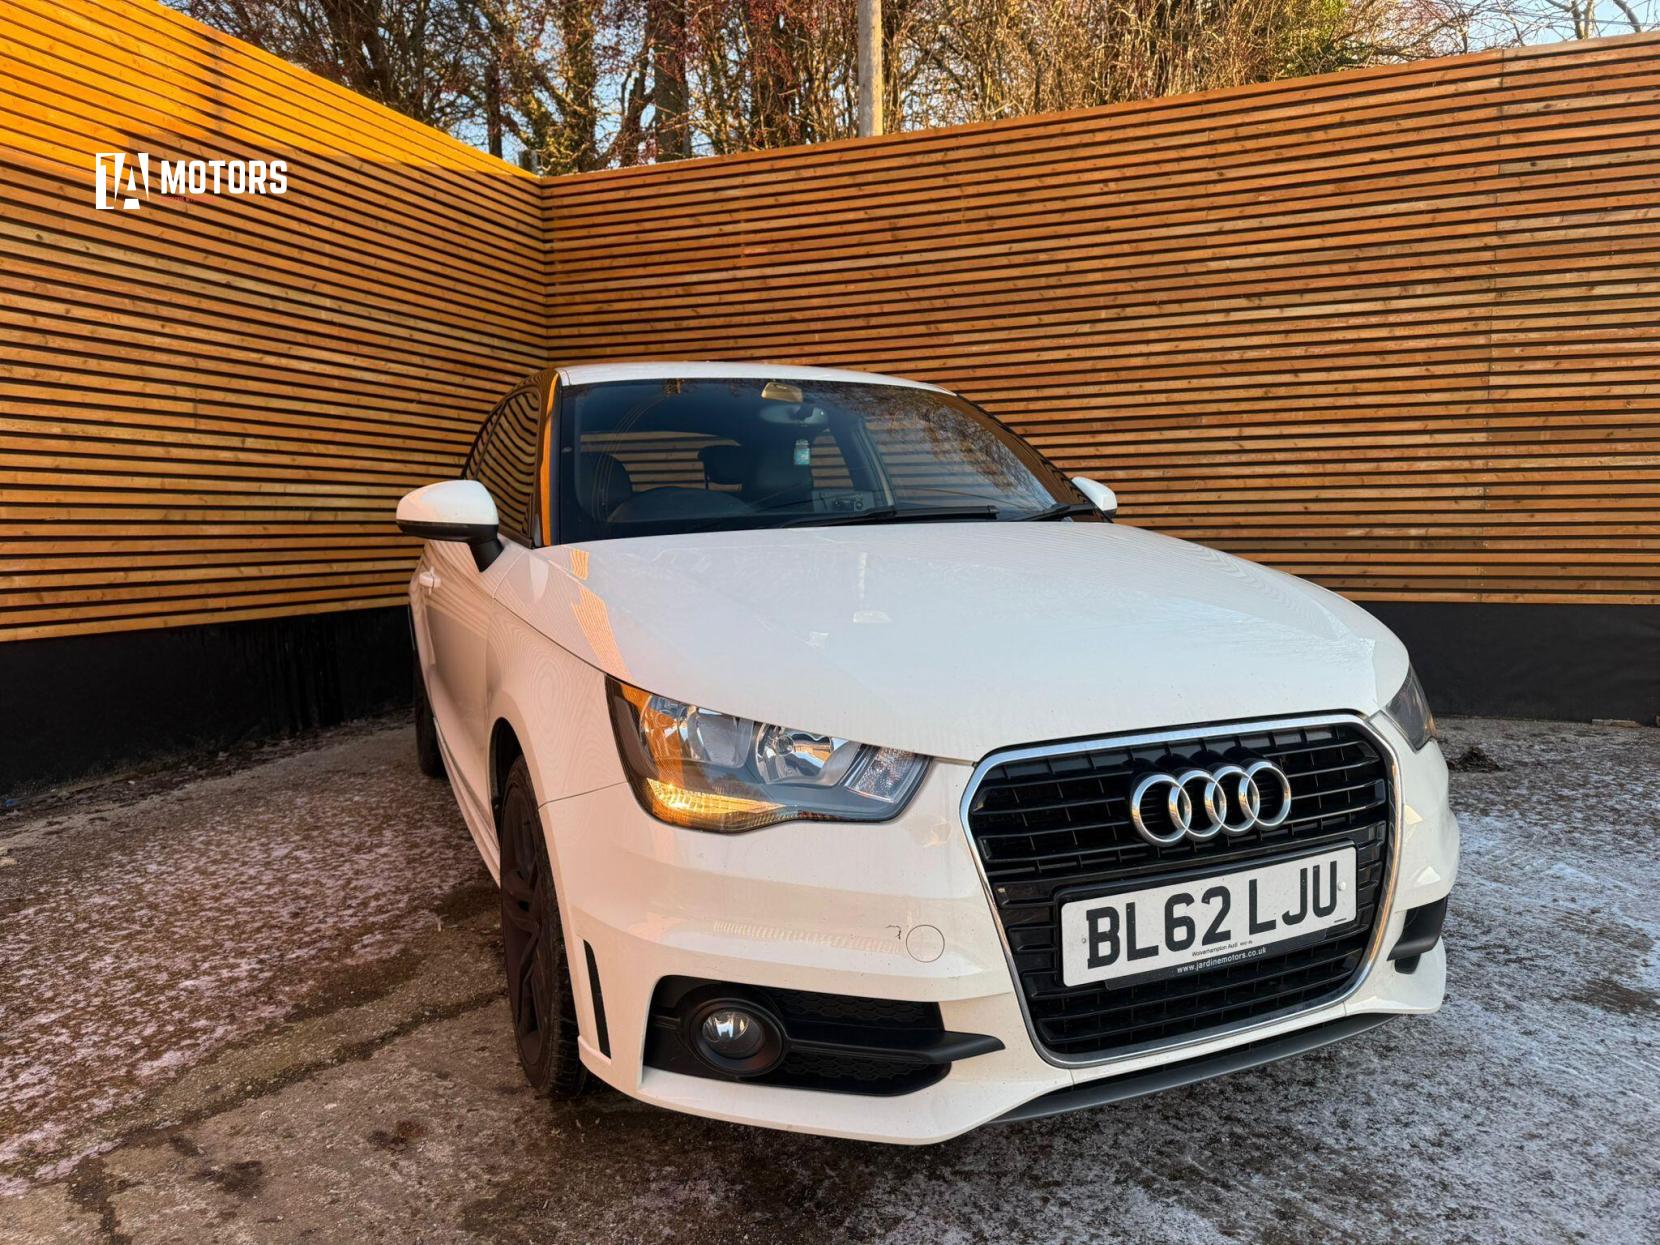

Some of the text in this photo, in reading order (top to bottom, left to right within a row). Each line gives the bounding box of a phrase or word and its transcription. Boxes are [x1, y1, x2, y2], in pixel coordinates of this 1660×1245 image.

[1086, 860, 1338, 970] BL62 LJU
[1177, 947, 1267, 973] www.jardinemotors.co.uk
